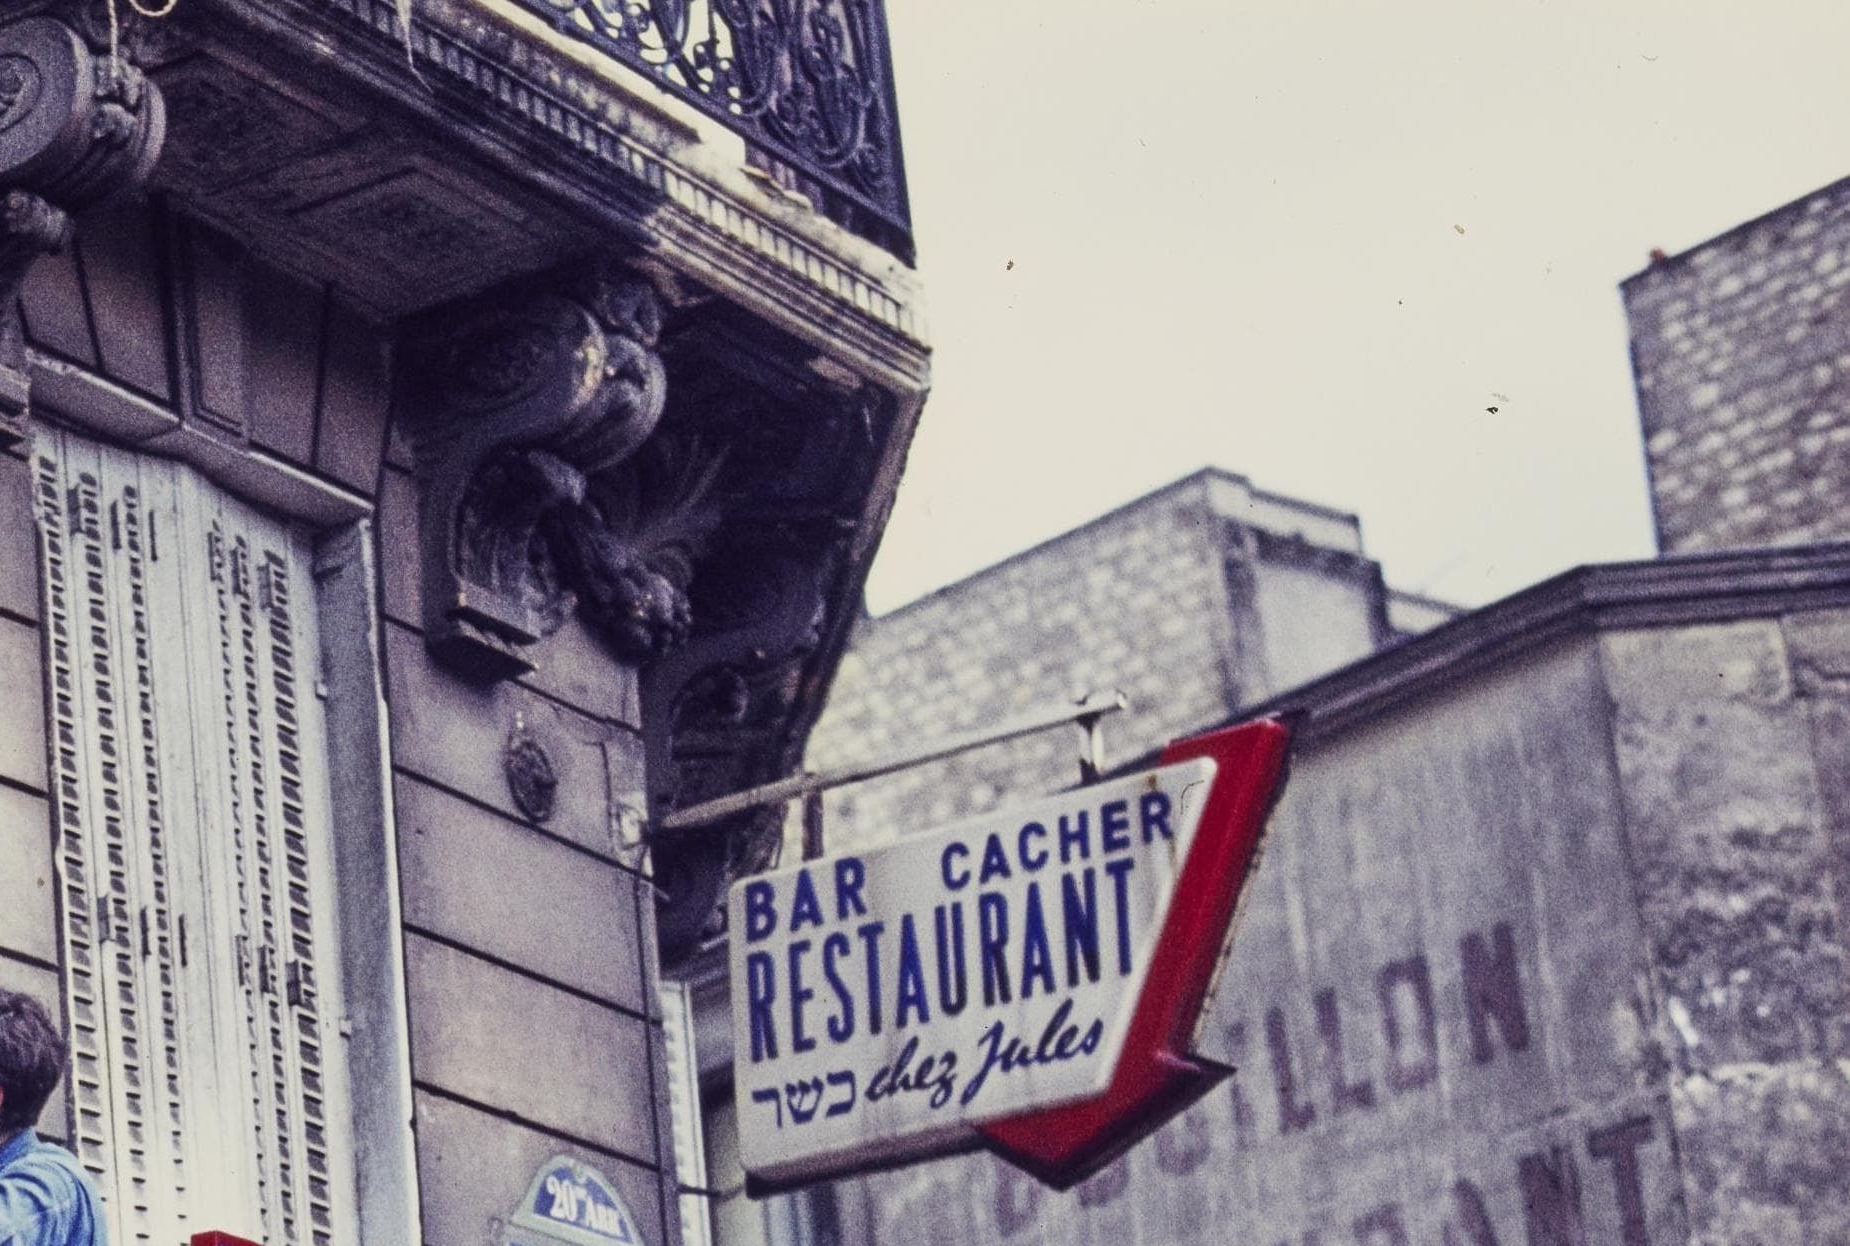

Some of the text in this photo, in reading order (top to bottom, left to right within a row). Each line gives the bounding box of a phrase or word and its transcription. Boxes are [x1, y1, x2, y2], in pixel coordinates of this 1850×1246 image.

[940, 790, 1173, 891] CACHER
[744, 856, 867, 944] BAR
[745, 857, 1136, 1064] RESTAURANT
[751, 1070, 857, 1130] כשר
[864, 1036, 959, 1109] chez
